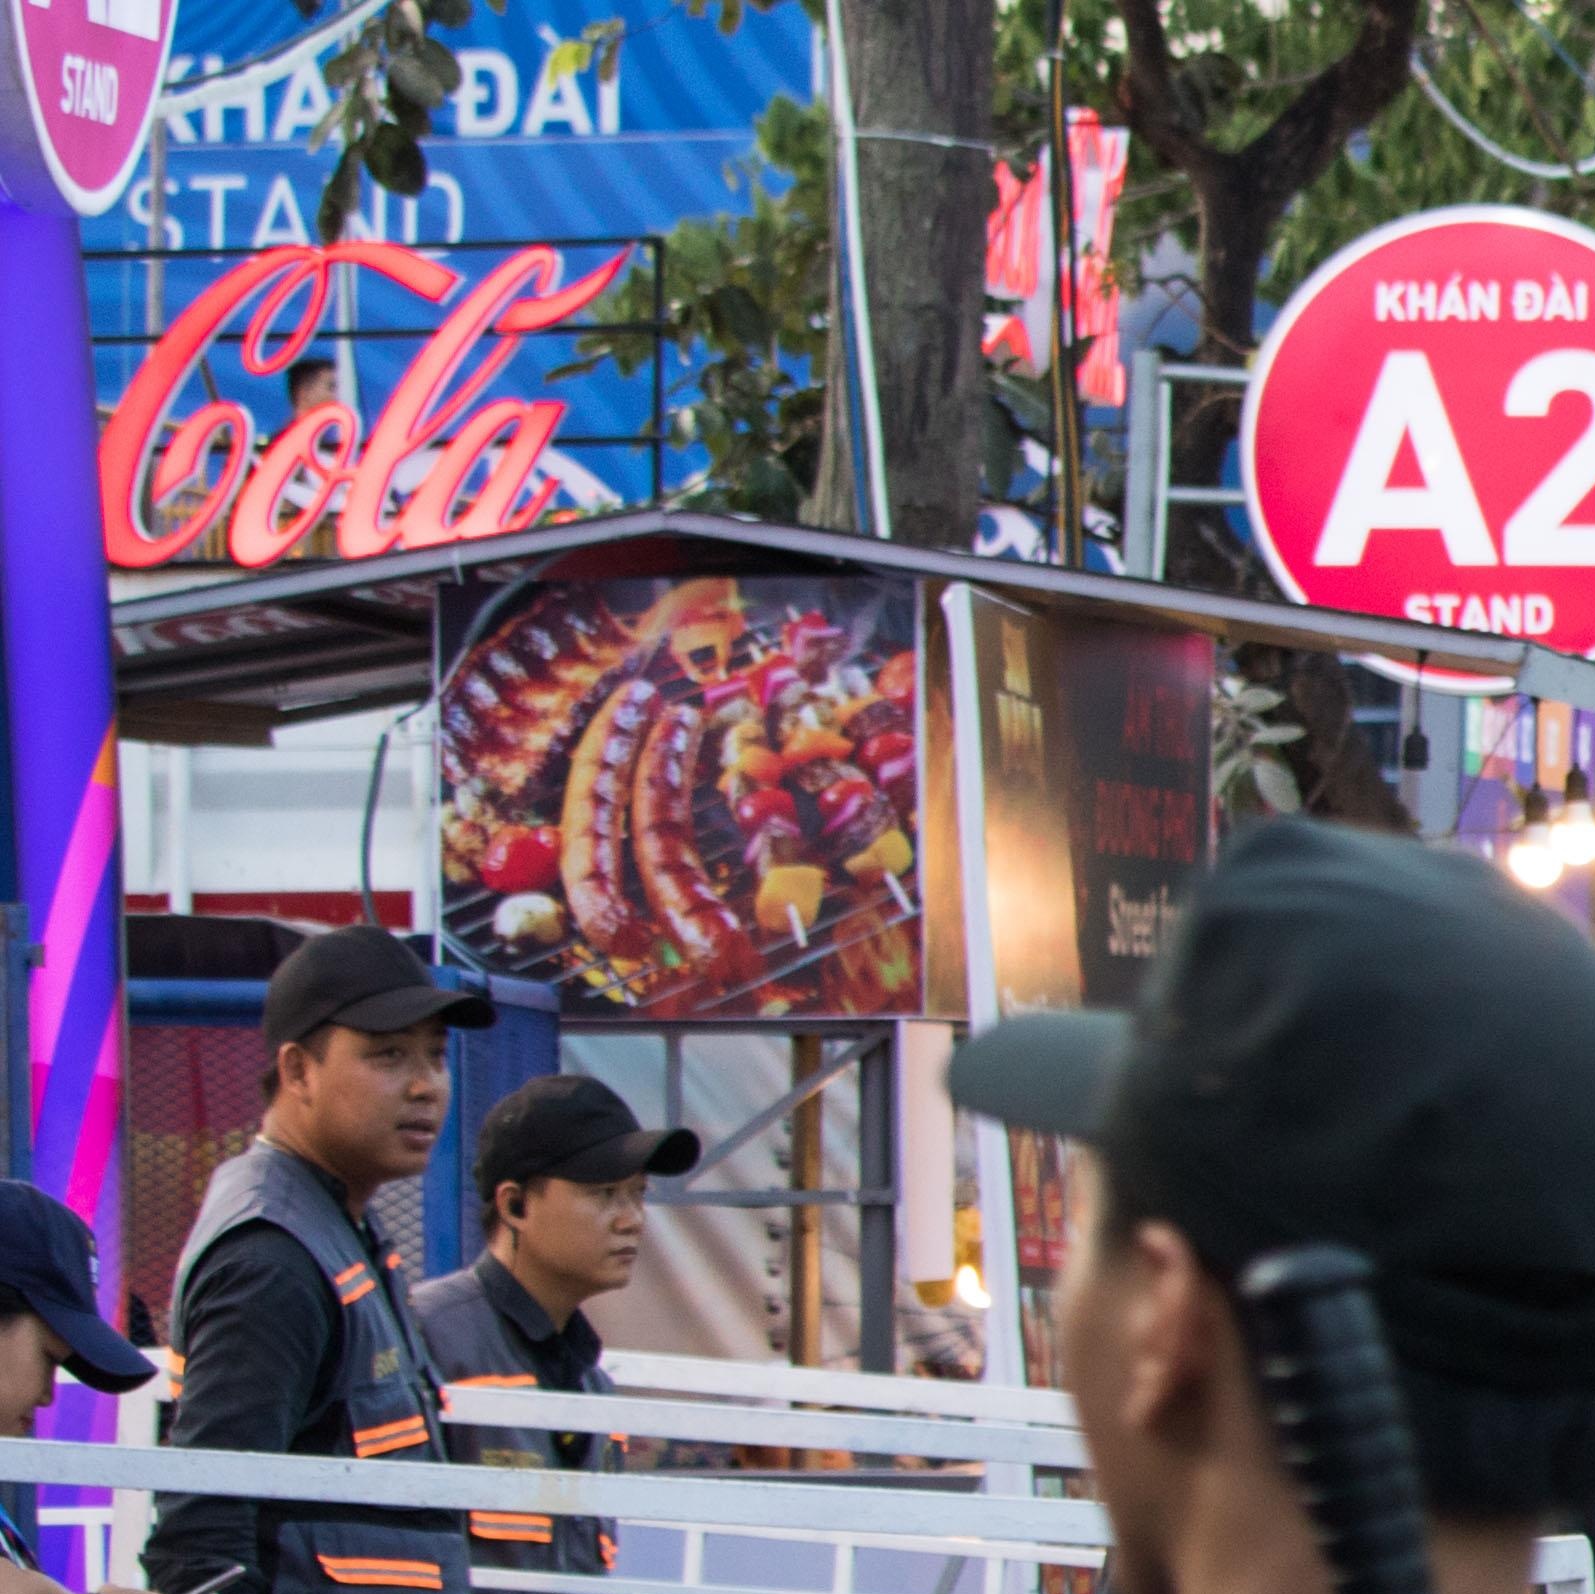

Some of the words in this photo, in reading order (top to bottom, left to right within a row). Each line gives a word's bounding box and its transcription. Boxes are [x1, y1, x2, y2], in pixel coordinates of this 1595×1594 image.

[60, 53, 119, 126] STAND
[1374, 272, 1501, 322] KHÁN
[1512, 272, 1588, 322] ĐÀI
[98, 240, 638, 568] Cola
[1404, 594, 1555, 635] STAND
